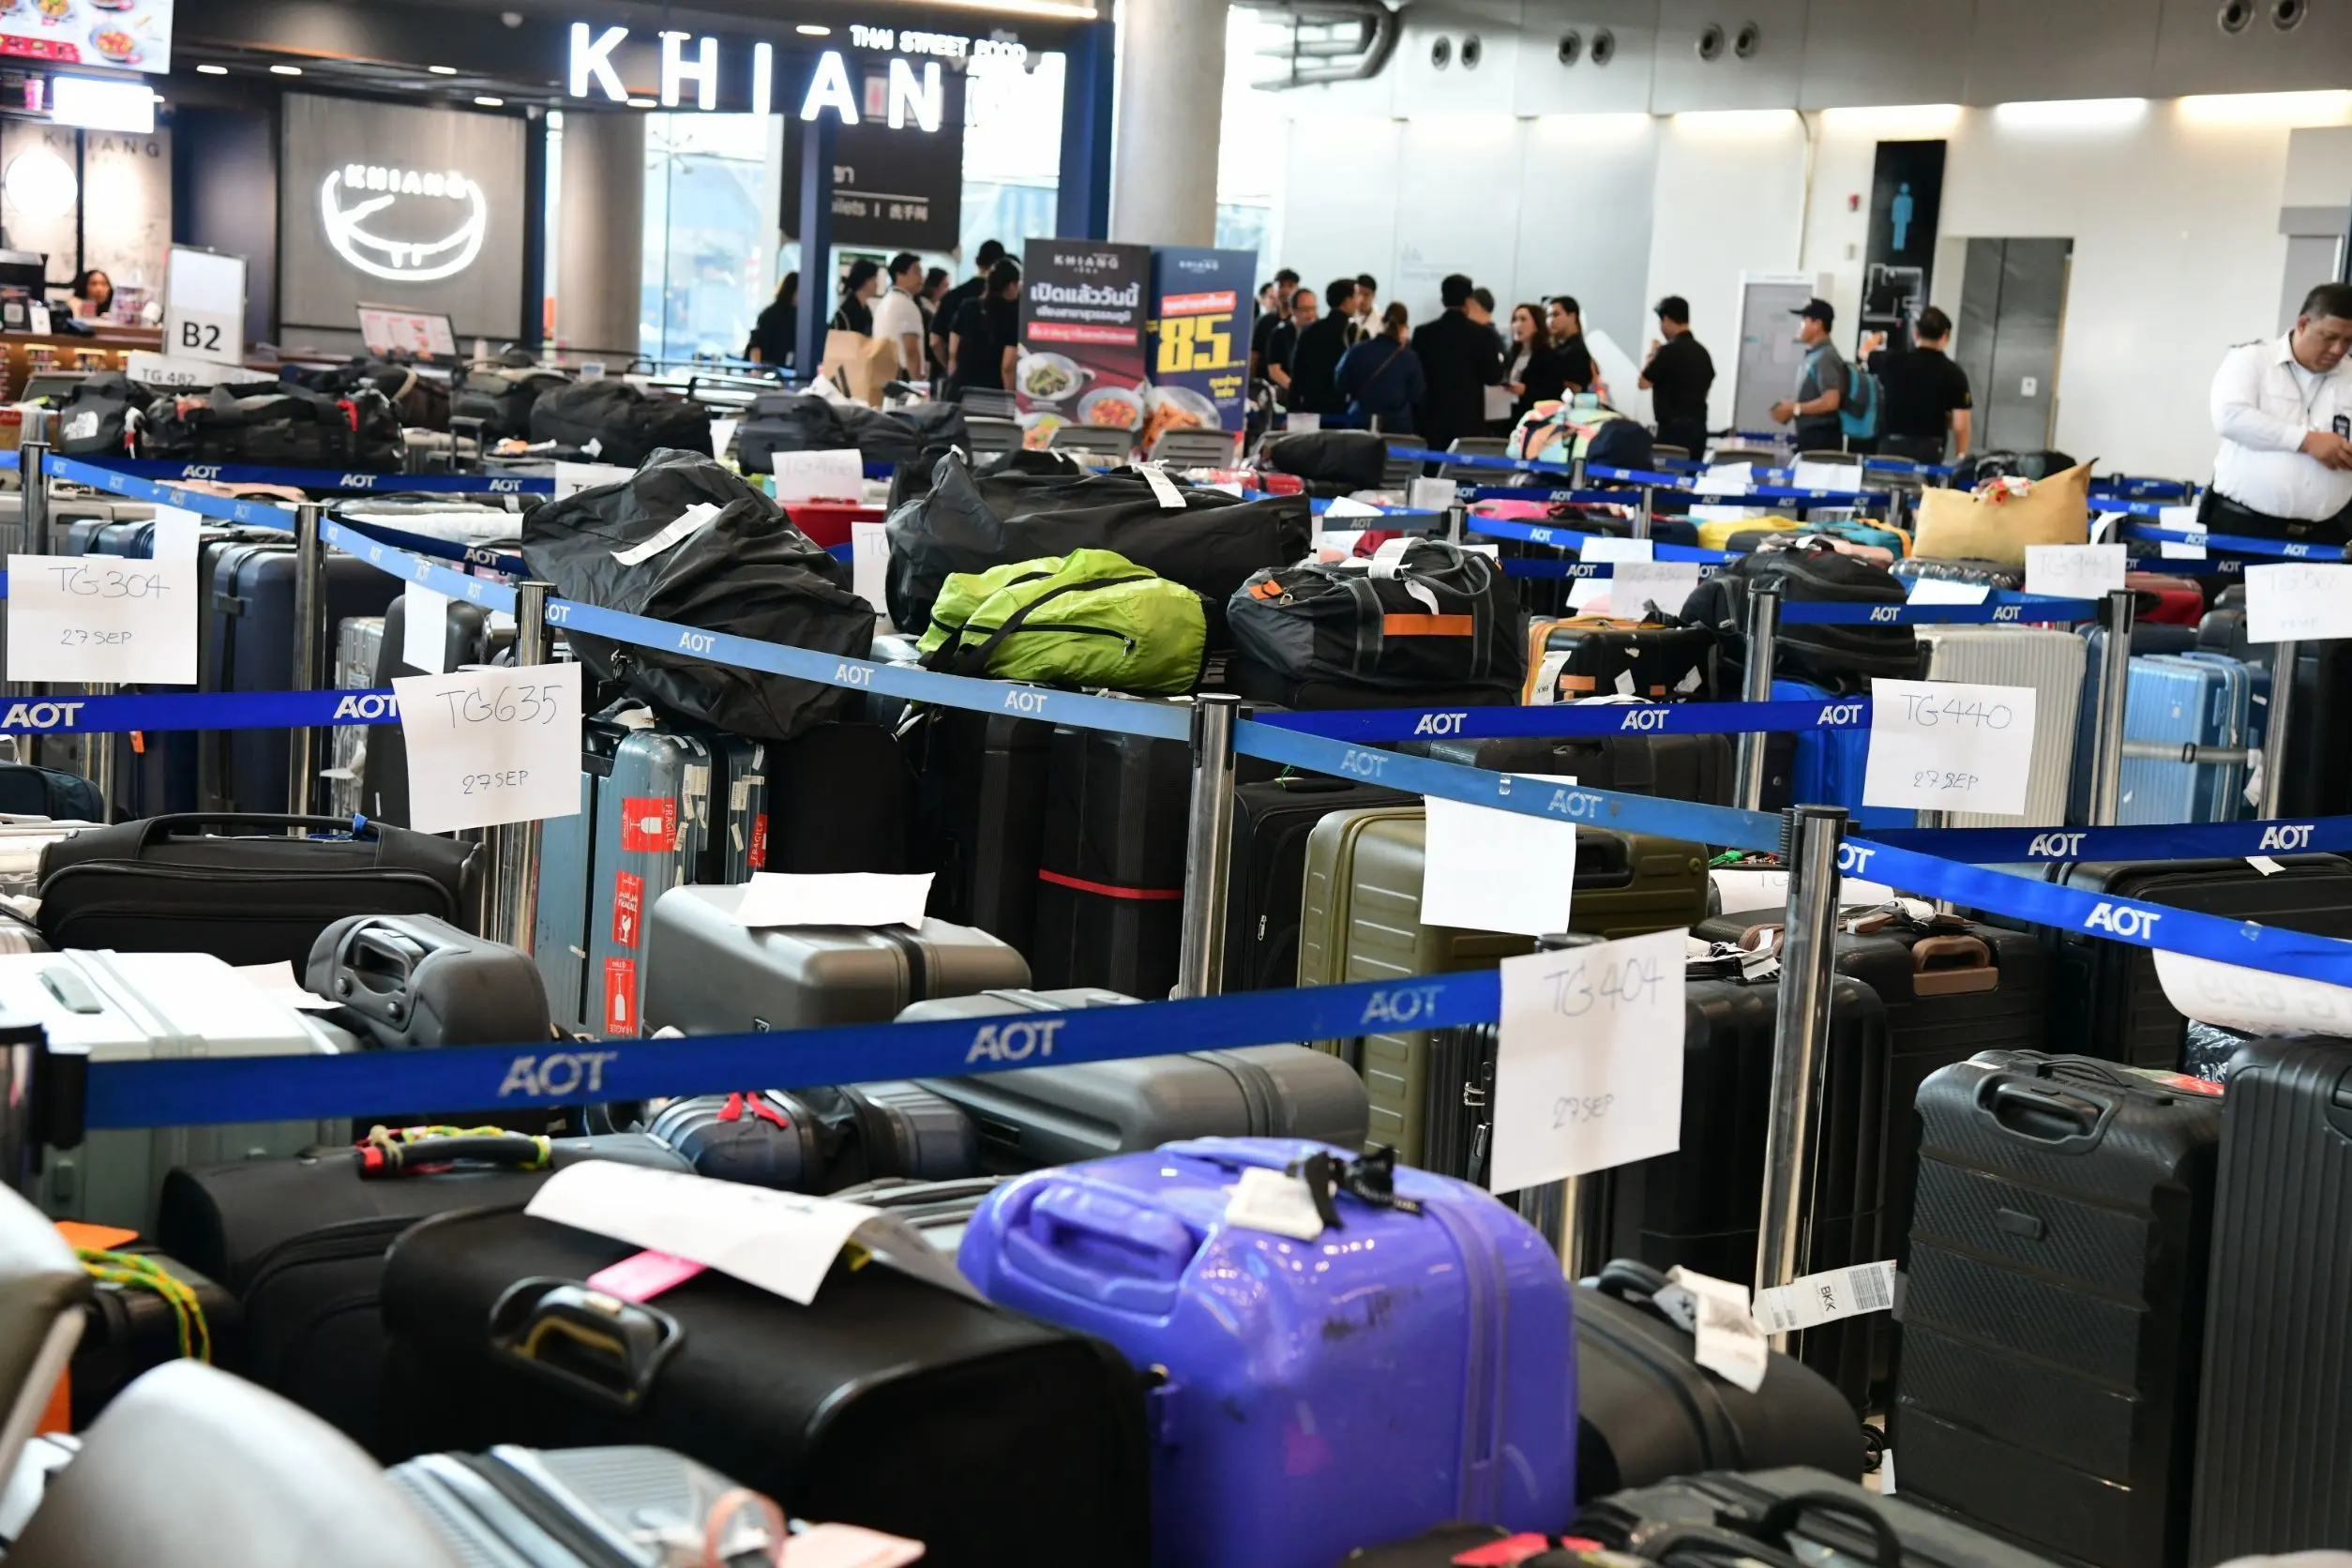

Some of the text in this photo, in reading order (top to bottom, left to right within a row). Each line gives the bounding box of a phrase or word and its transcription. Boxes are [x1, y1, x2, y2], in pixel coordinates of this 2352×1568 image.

[569, 23, 941, 133] KHIAN
[345, 163, 466, 199] KHIANG
[1053, 253, 1120, 269] KHIANG
[182, 322, 221, 352] B2
[1156, 312, 1233, 373] 85
[142, 368, 162, 383] TG
[182, 464, 221, 478] AOT
[339, 473, 377, 489] AOT
[490, 479, 523, 493] AOT
[1550, 490, 1574, 502] AOT
[1350, 518, 1374, 529] AOT
[1530, 528, 1553, 542] AOT
[2185, 533, 2209, 547] AOT
[2283, 543, 2310, 557] AOT
[464, 548, 500, 567] AOT
[2217, 561, 2241, 573] AOT
[47, 563, 171, 598] TG304
[1566, 565, 1598, 578] AOT
[1699, 565, 1718, 579] OT
[1870, 606, 1901, 622] AOT
[1993, 606, 2022, 621] AOT
[679, 631, 716, 654] AOT
[835, 663, 876, 686] AOT
[333, 693, 400, 719] AOT
[435, 683, 564, 729] TG635
[1003, 690, 1048, 713] AOT
[1900, 693, 2013, 730] TG440
[1, 701, 85, 729] AOT
[1414, 713, 1468, 735] AOT
[1620, 709, 1670, 731] AOT
[1817, 704, 1863, 725] AOT
[1339, 749, 1389, 777] AOT
[1547, 789, 1603, 820] AOT
[665, 804, 675, 844] FRAGILE
[2028, 832, 2088, 857] AOT
[2258, 824, 2315, 850] AOT
[1838, 841, 1876, 874] OT
[2083, 902, 2162, 940] AOT
[1543, 957, 1666, 1018] TG404
[1360, 985, 1447, 1025] AOT
[965, 1018, 1066, 1064] AOT
[497, 1051, 619, 1098] AOT
[1820, 1286, 1837, 1313] BKK
